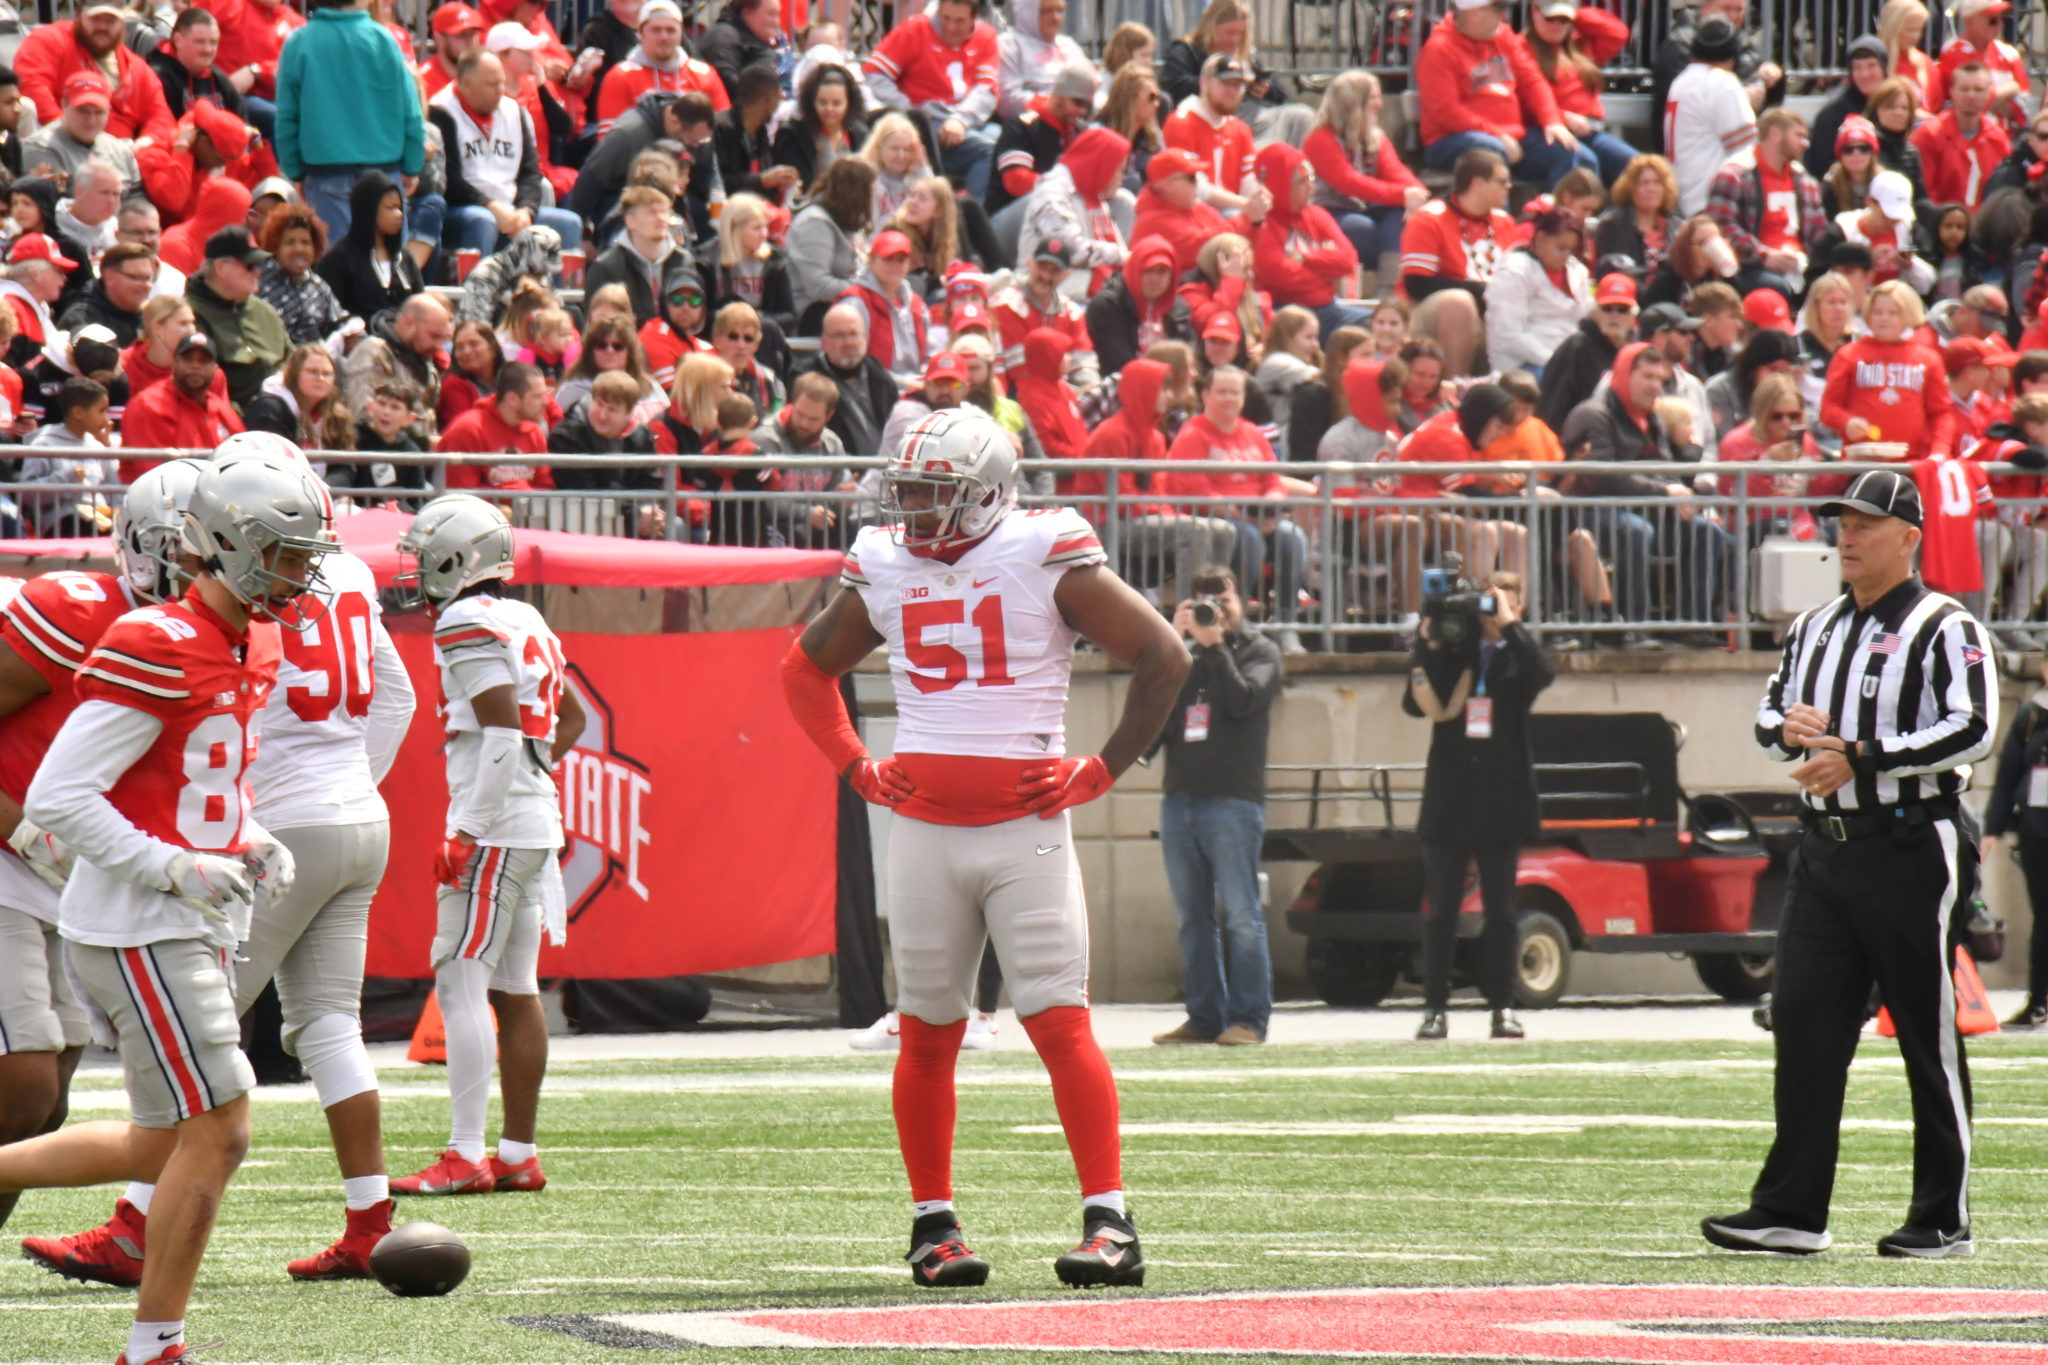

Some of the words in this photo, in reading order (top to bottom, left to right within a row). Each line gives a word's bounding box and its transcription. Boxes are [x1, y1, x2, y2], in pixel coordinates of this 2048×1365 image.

[279, 590, 376, 722] 90
[901, 594, 1016, 695] 51
[1817, 631, 1831, 647] S
[1861, 674, 1881, 699] U
[553, 750, 652, 902] TATE
